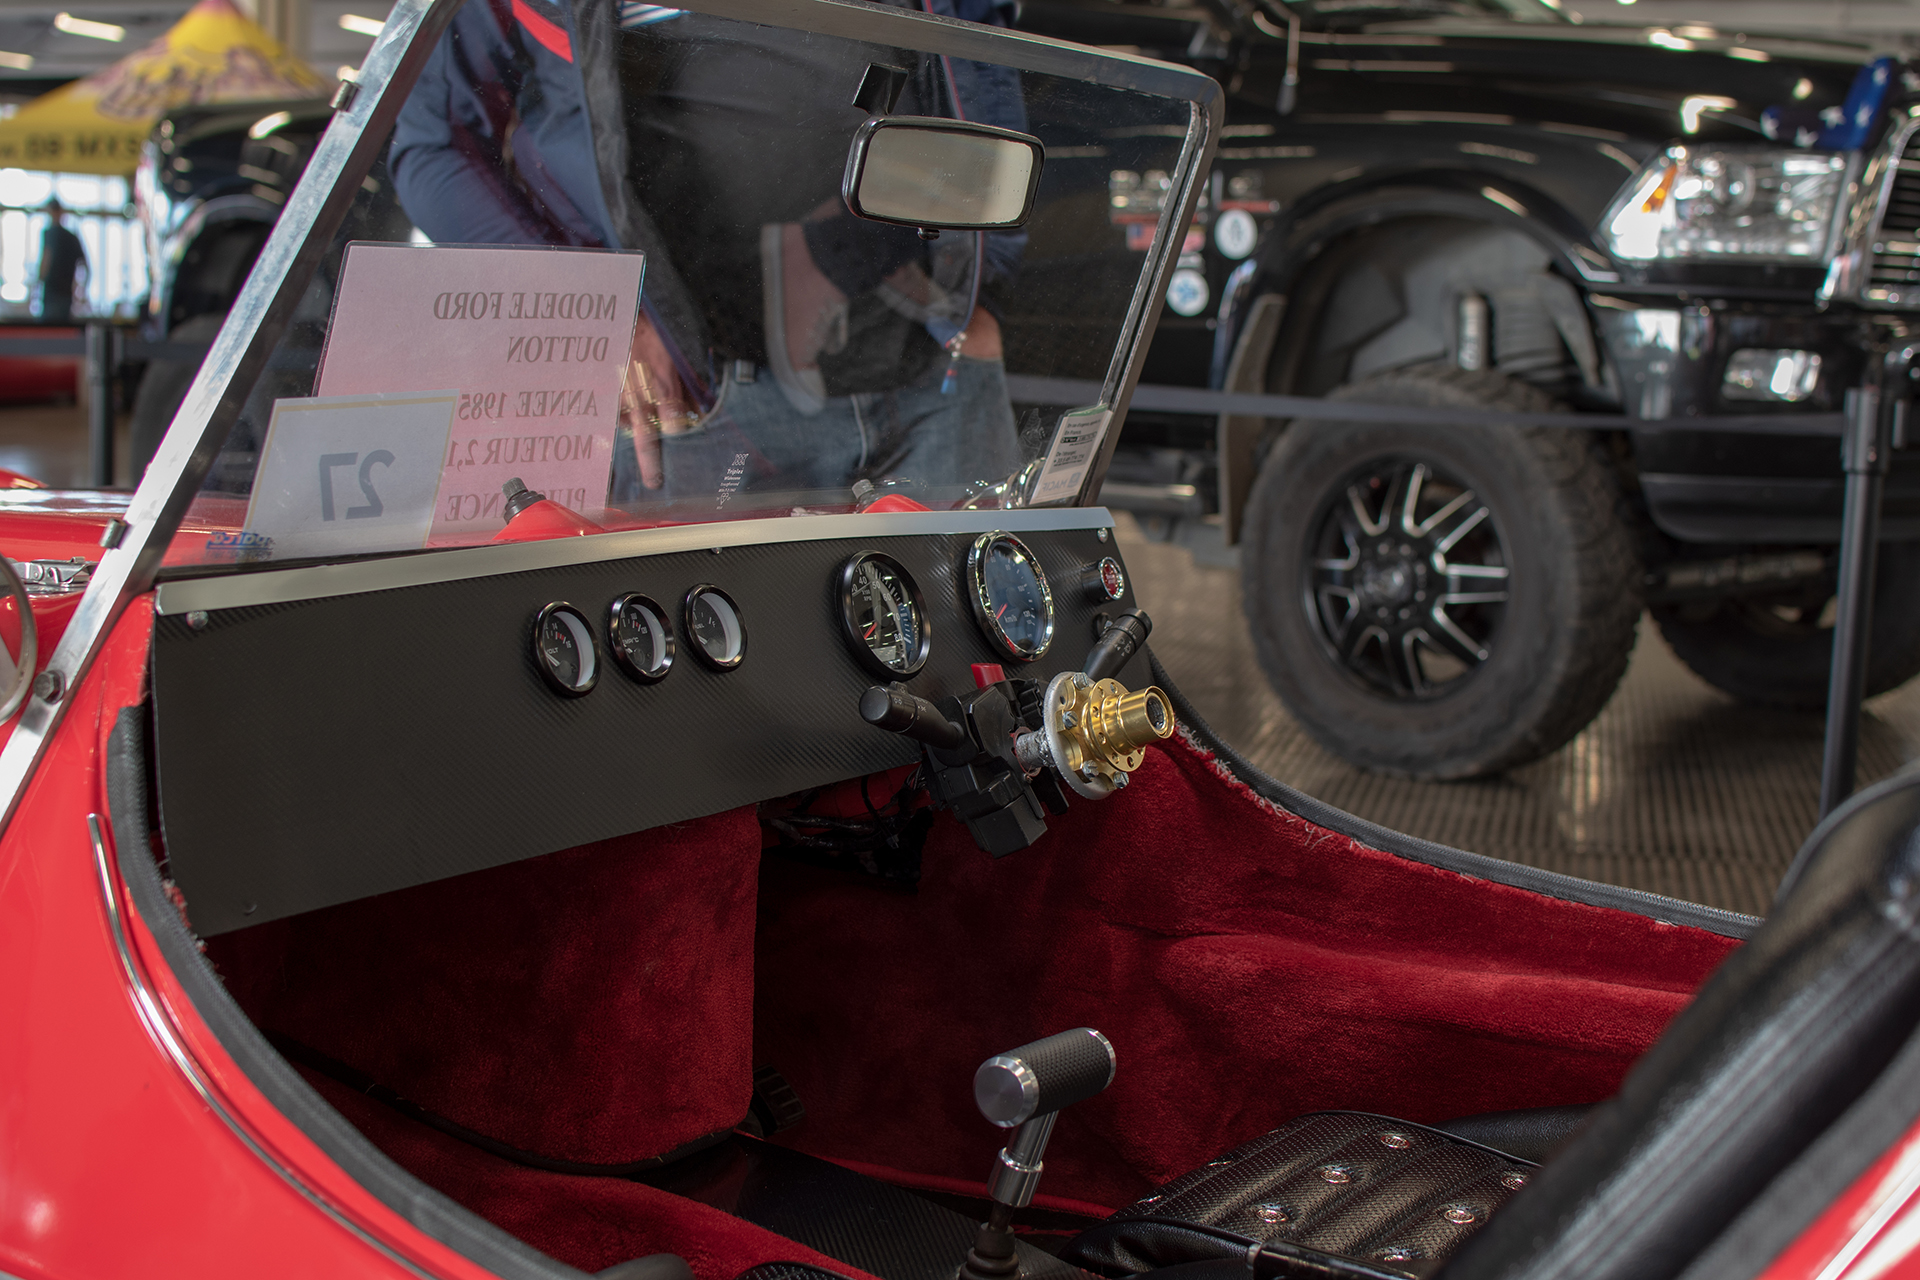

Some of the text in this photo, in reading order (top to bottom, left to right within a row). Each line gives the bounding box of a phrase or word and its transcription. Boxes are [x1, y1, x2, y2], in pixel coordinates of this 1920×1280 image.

[858, 576, 868, 585] 40
[872, 581, 881, 590] 50
[882, 593, 892, 602] 60
